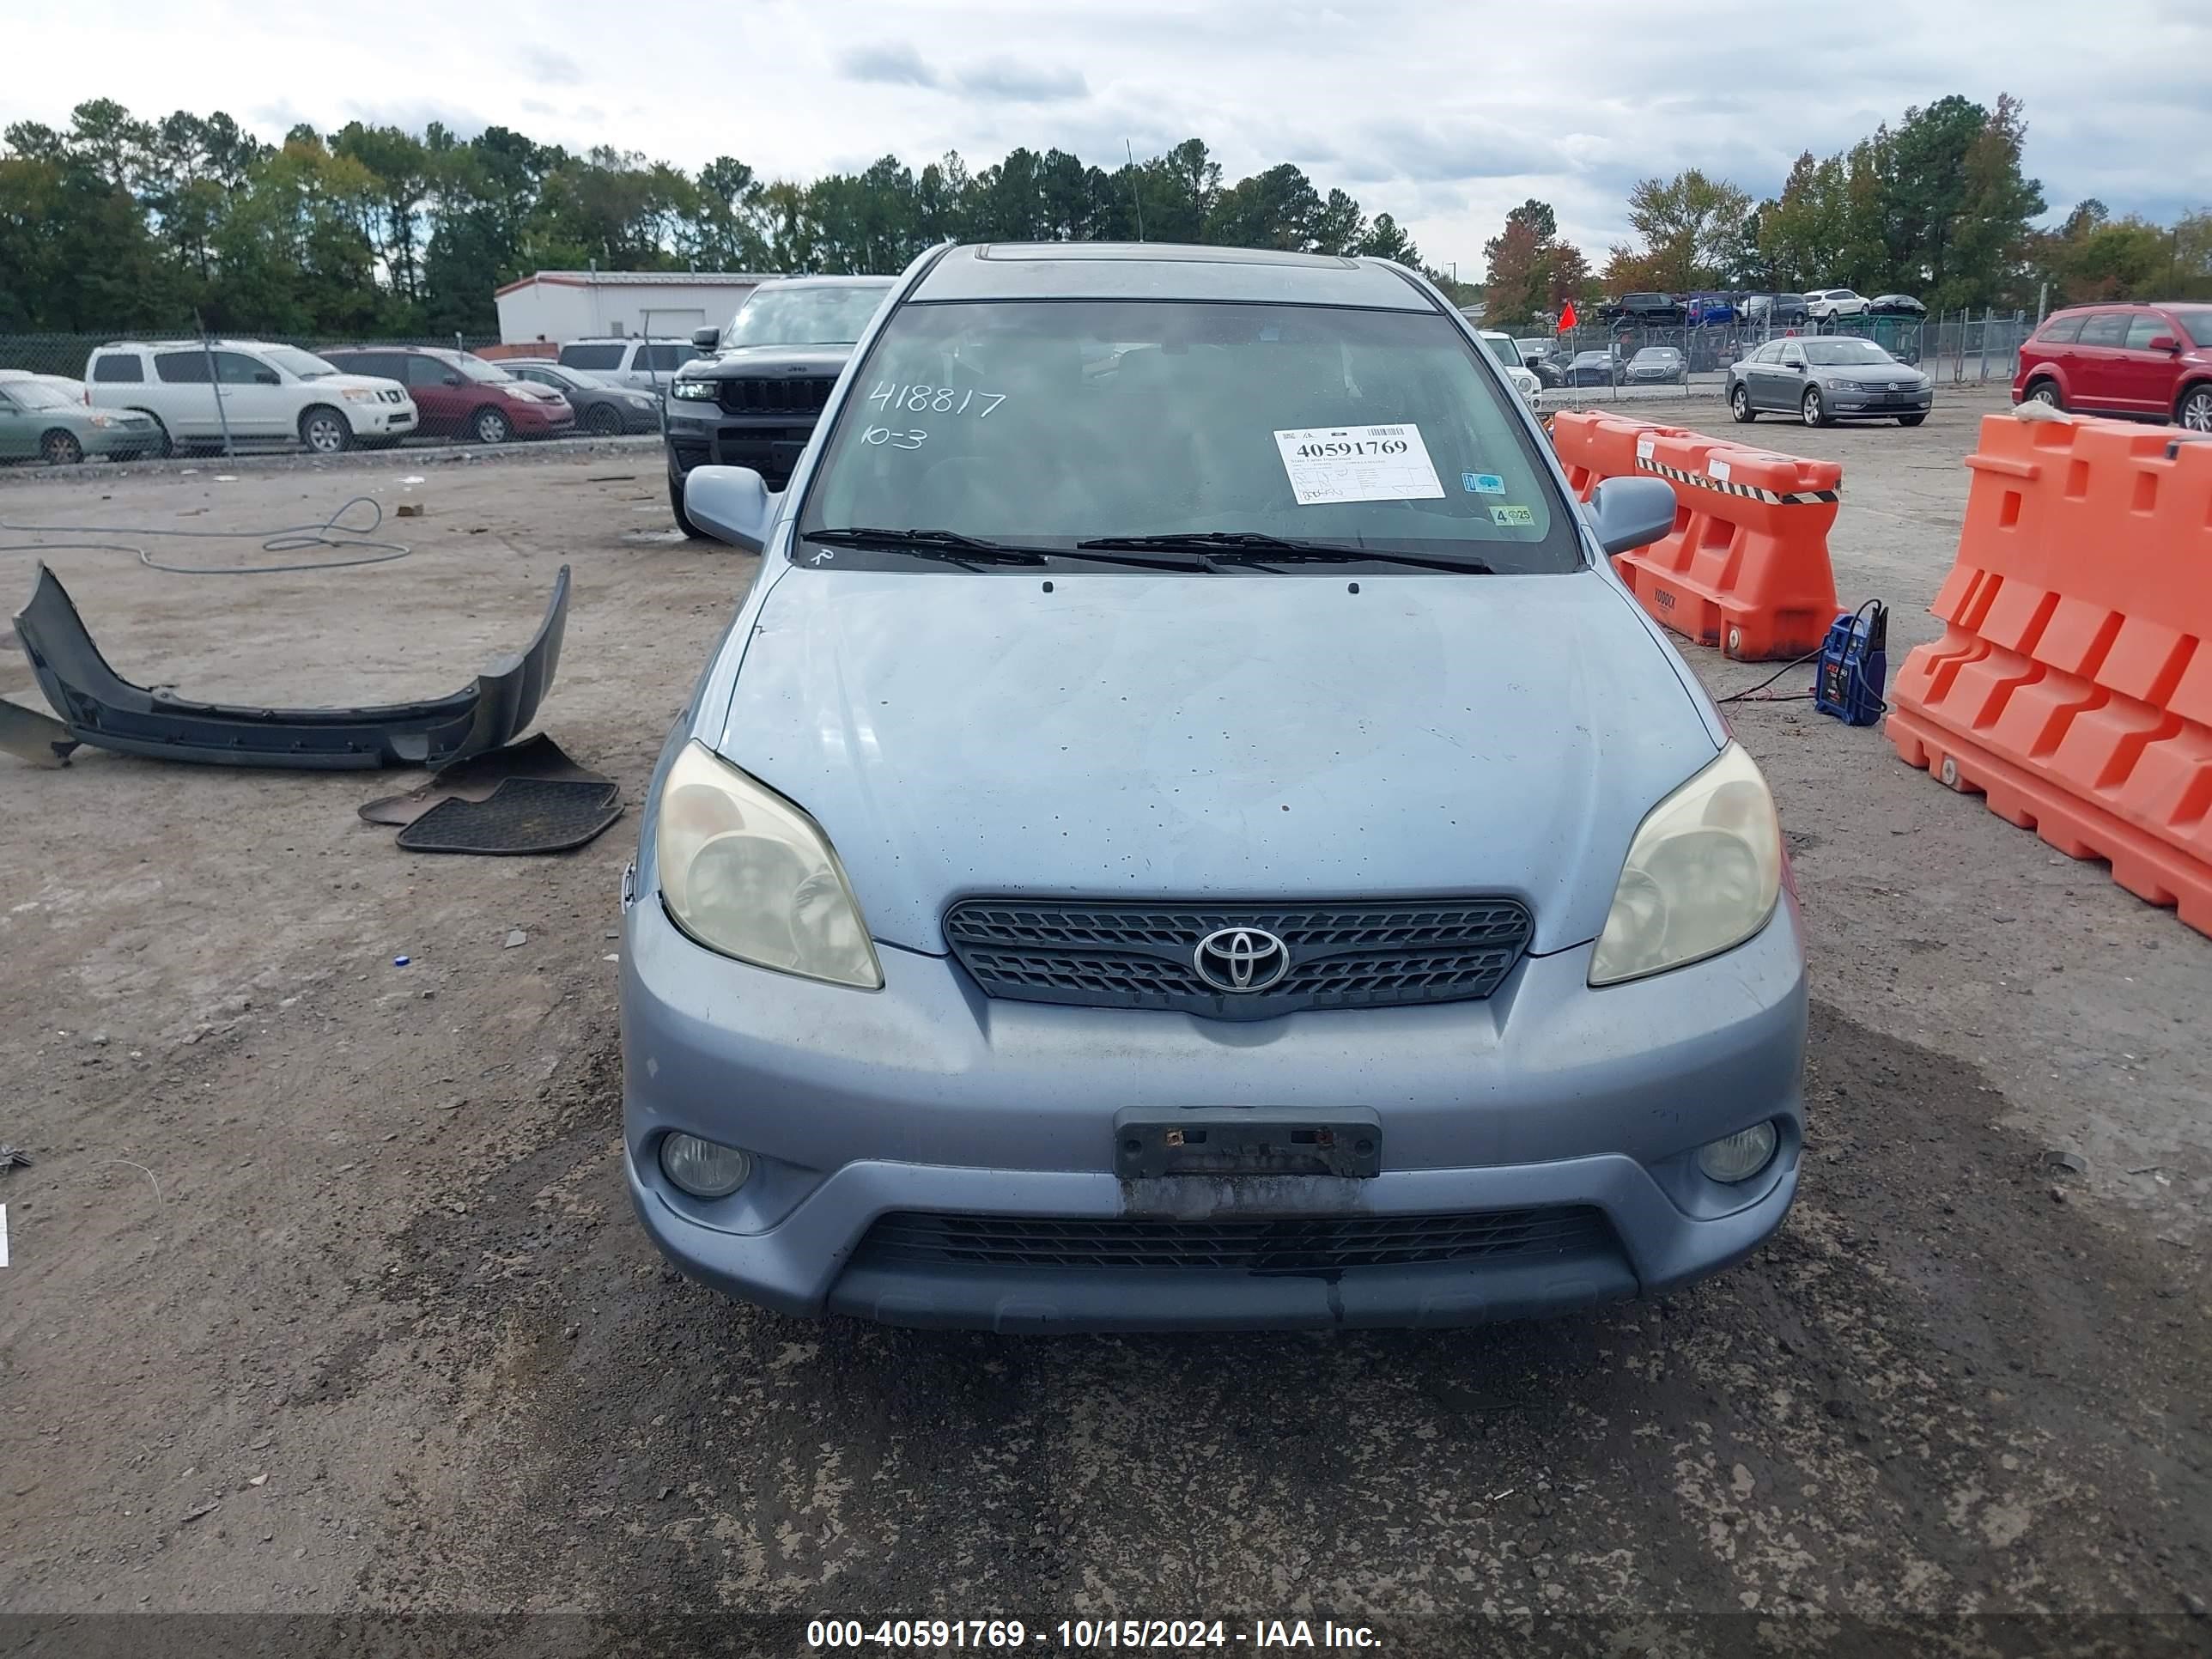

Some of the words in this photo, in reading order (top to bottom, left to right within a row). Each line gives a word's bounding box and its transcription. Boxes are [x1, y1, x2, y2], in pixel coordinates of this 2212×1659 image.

[869, 380, 1006, 417] 418817
[861, 424, 927, 450] 10-3
[1297, 440, 1408, 458] 40591769
[1498, 510, 1507, 522] 4
[1518, 510, 1530, 520] 25
